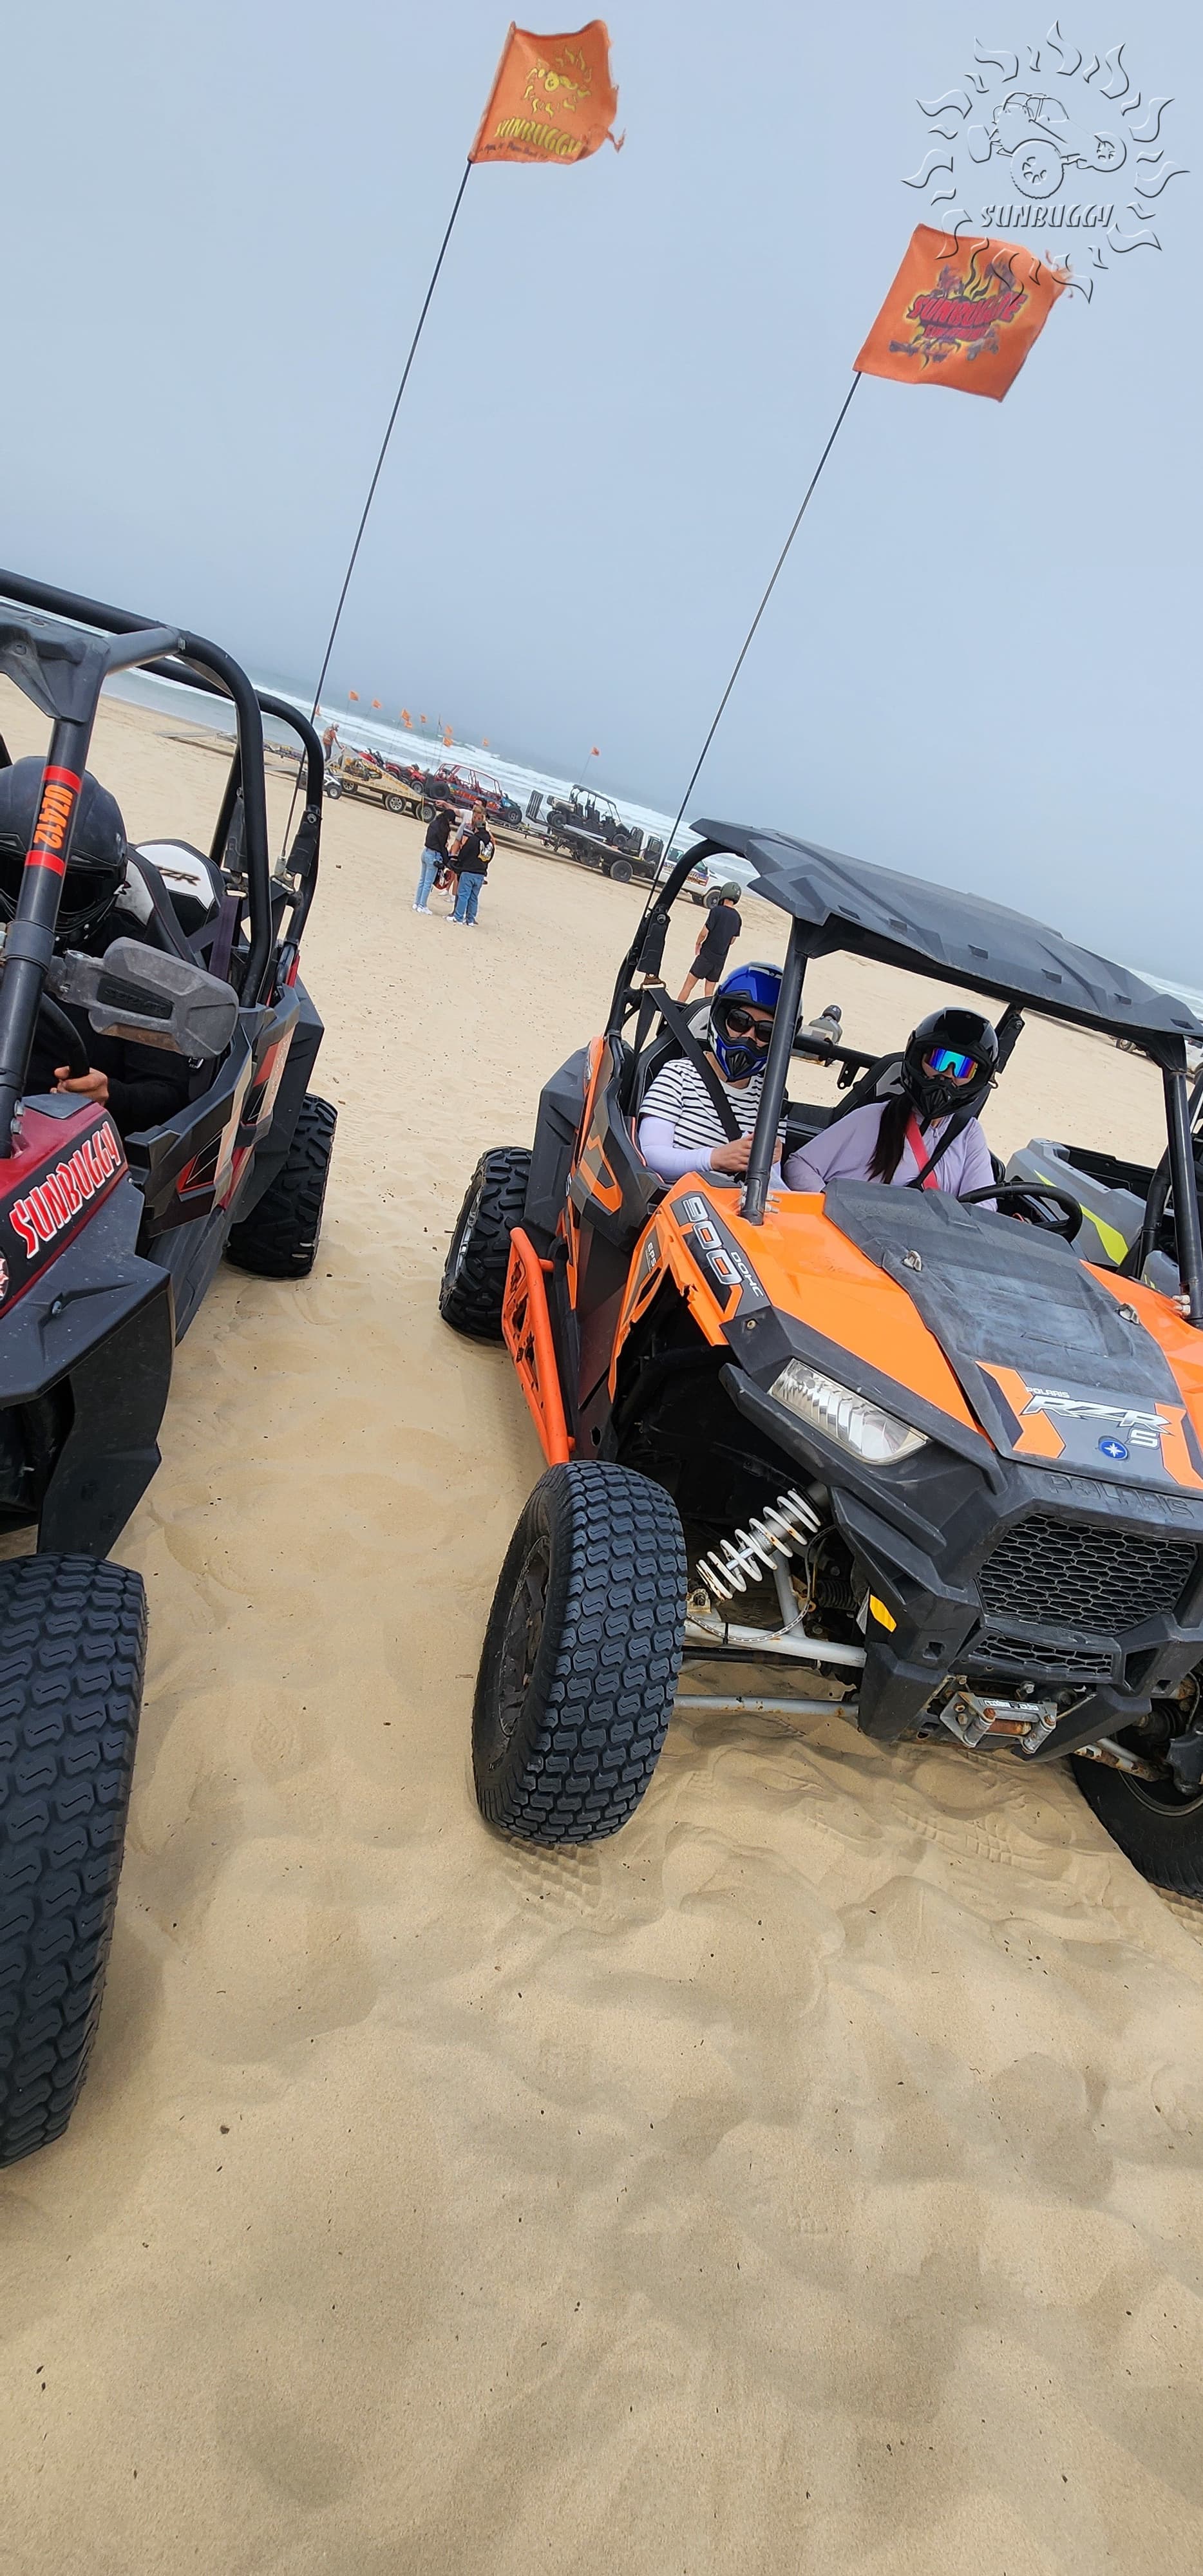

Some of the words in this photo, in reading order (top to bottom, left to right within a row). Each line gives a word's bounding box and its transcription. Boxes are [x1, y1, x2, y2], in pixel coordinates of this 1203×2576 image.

[9, 1121, 122, 1260] SUNBUGGY
[648, 1242, 657, 1268] EPS
[682, 1195, 743, 1285] 900
[730, 1251, 764, 1298] DOHC
[1025, 1386, 1070, 1399] POLARIS
[1019, 1394, 1173, 1436] RZR
[1129, 1427, 1159, 1450] S
[1045, 1472, 1195, 1519] POLARIS
